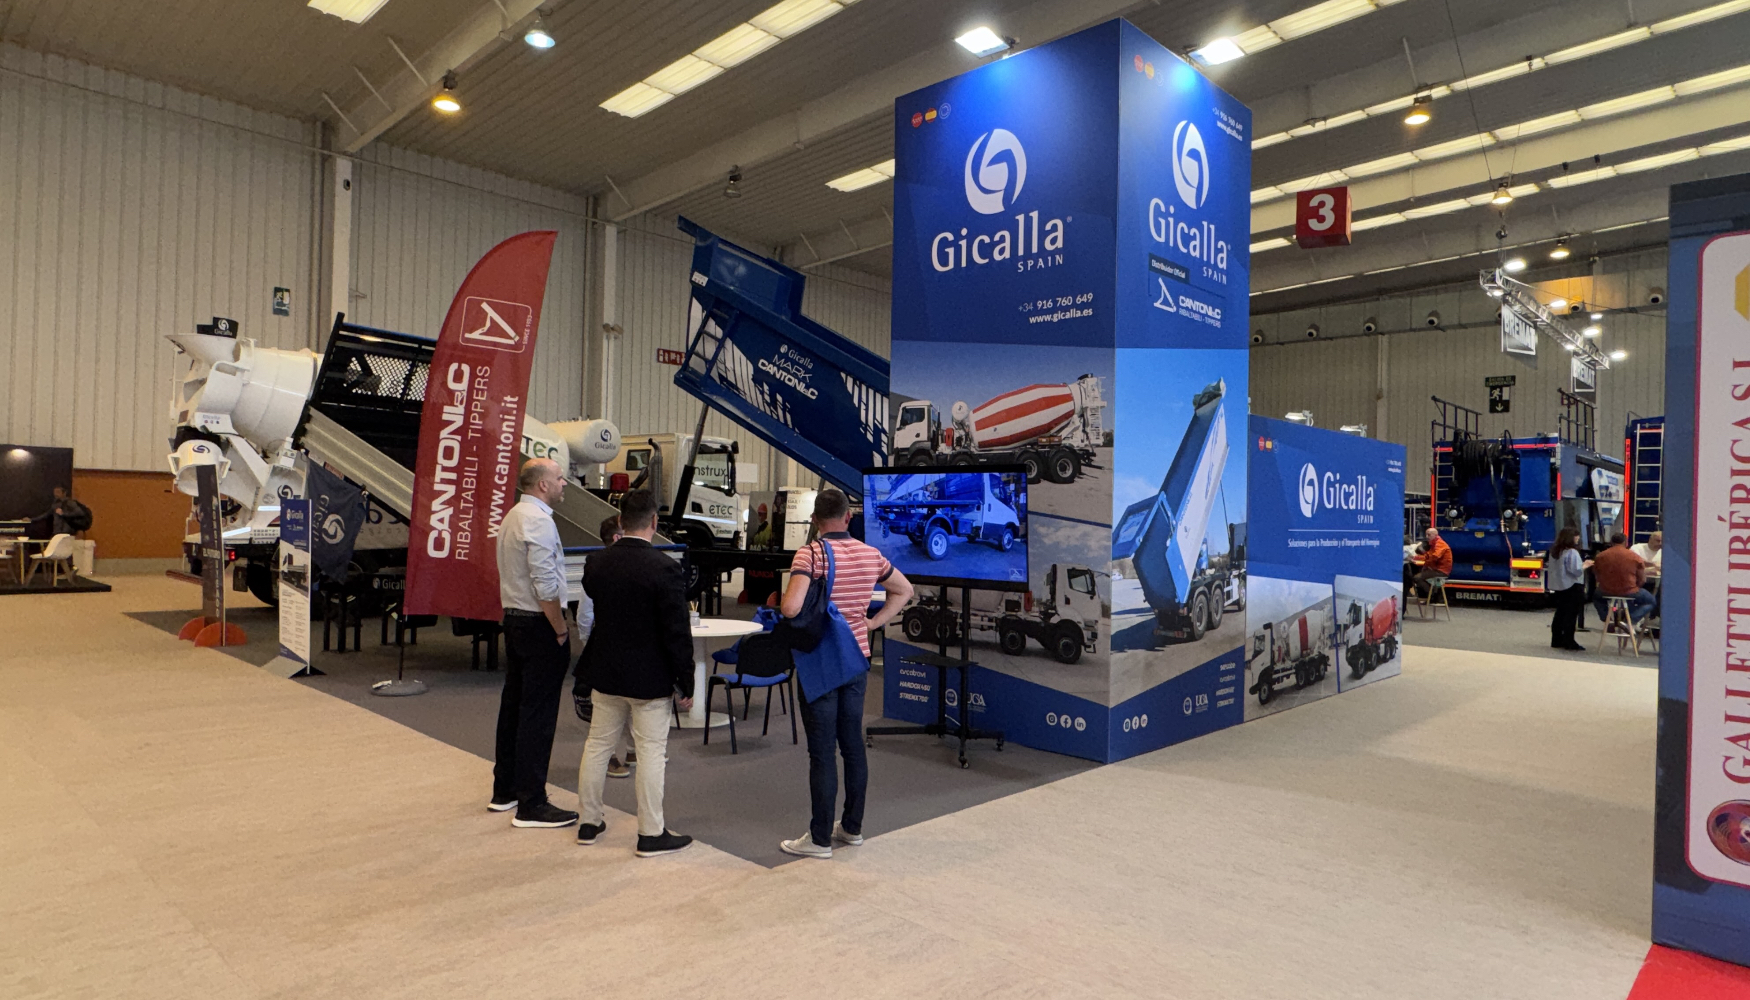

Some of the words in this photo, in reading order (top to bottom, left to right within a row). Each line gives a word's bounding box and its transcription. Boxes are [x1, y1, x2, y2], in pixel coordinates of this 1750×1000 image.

[1307, 193, 1335, 231] 3
[931, 210, 1064, 272] Gicalla
[1149, 198, 1227, 270] Gicalla
[1018, 254, 1063, 272] SPAIN
[1202, 266, 1227, 285] SPAIN
[1018, 302, 1033, 313] +34
[1037, 299, 1053, 310] 916
[1056, 296, 1073, 307] 760
[1075, 292, 1094, 304] 649
[1029, 308, 1093, 324] www.gicalla.es
[773, 354, 812, 382] MARK
[788, 349, 813, 370] Gicalla
[456, 456, 479, 560] RIBALTABILI
[468, 366, 491, 440] TIPPERS
[487, 395, 519, 539] www.cantoni.it
[1323, 471, 1374, 511] Gicalla
[1357, 514, 1374, 524] SPAIN
[382, 579, 406, 590] Gicall
[1455, 591, 1499, 601] BREMAT
